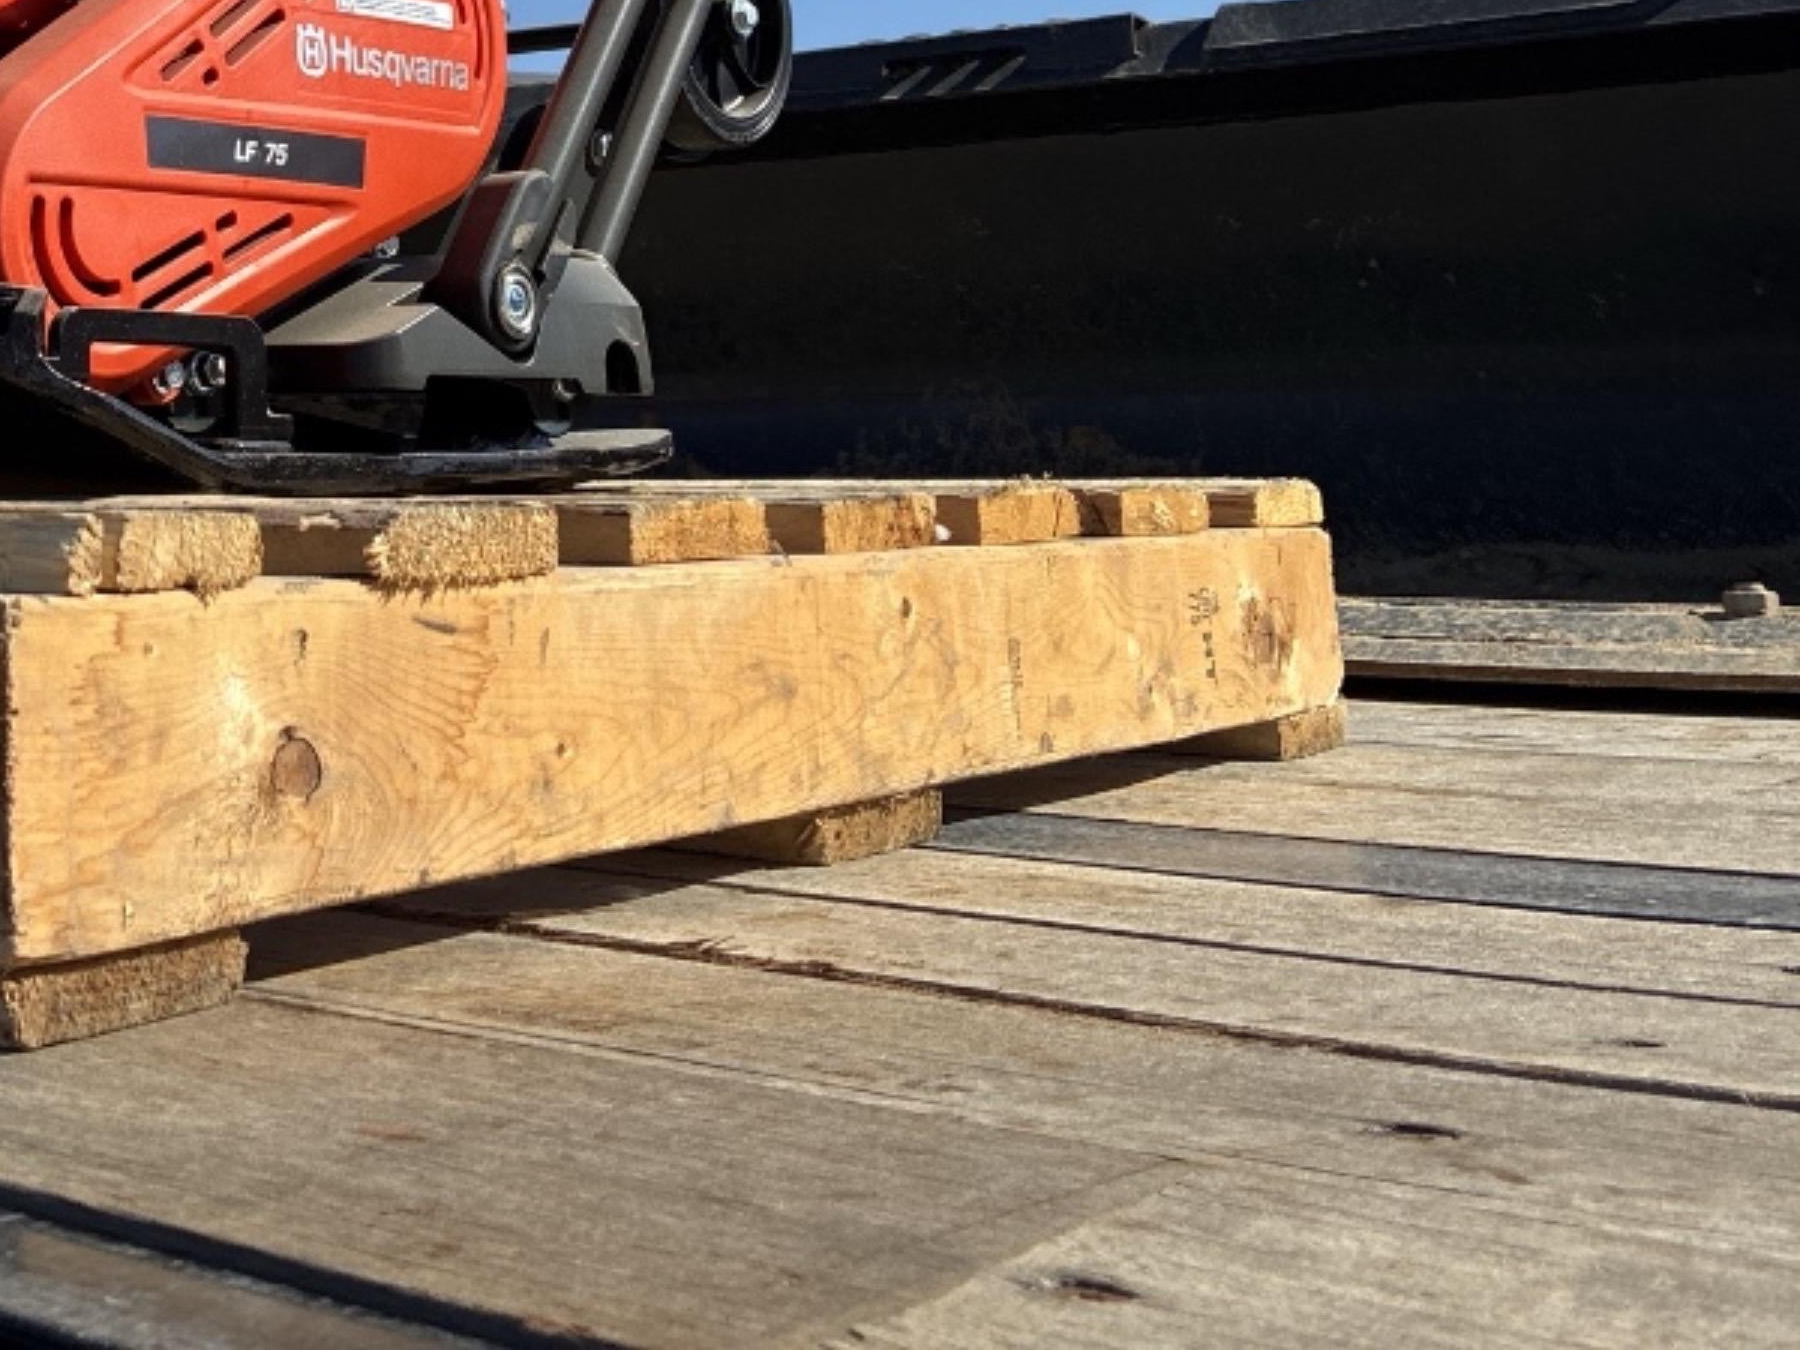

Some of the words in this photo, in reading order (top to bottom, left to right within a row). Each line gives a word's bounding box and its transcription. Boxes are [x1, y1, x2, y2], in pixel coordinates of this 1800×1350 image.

[328, 31, 470, 92] Husqvarna
[233, 138, 259, 163] LF
[263, 142, 290, 167] 75
